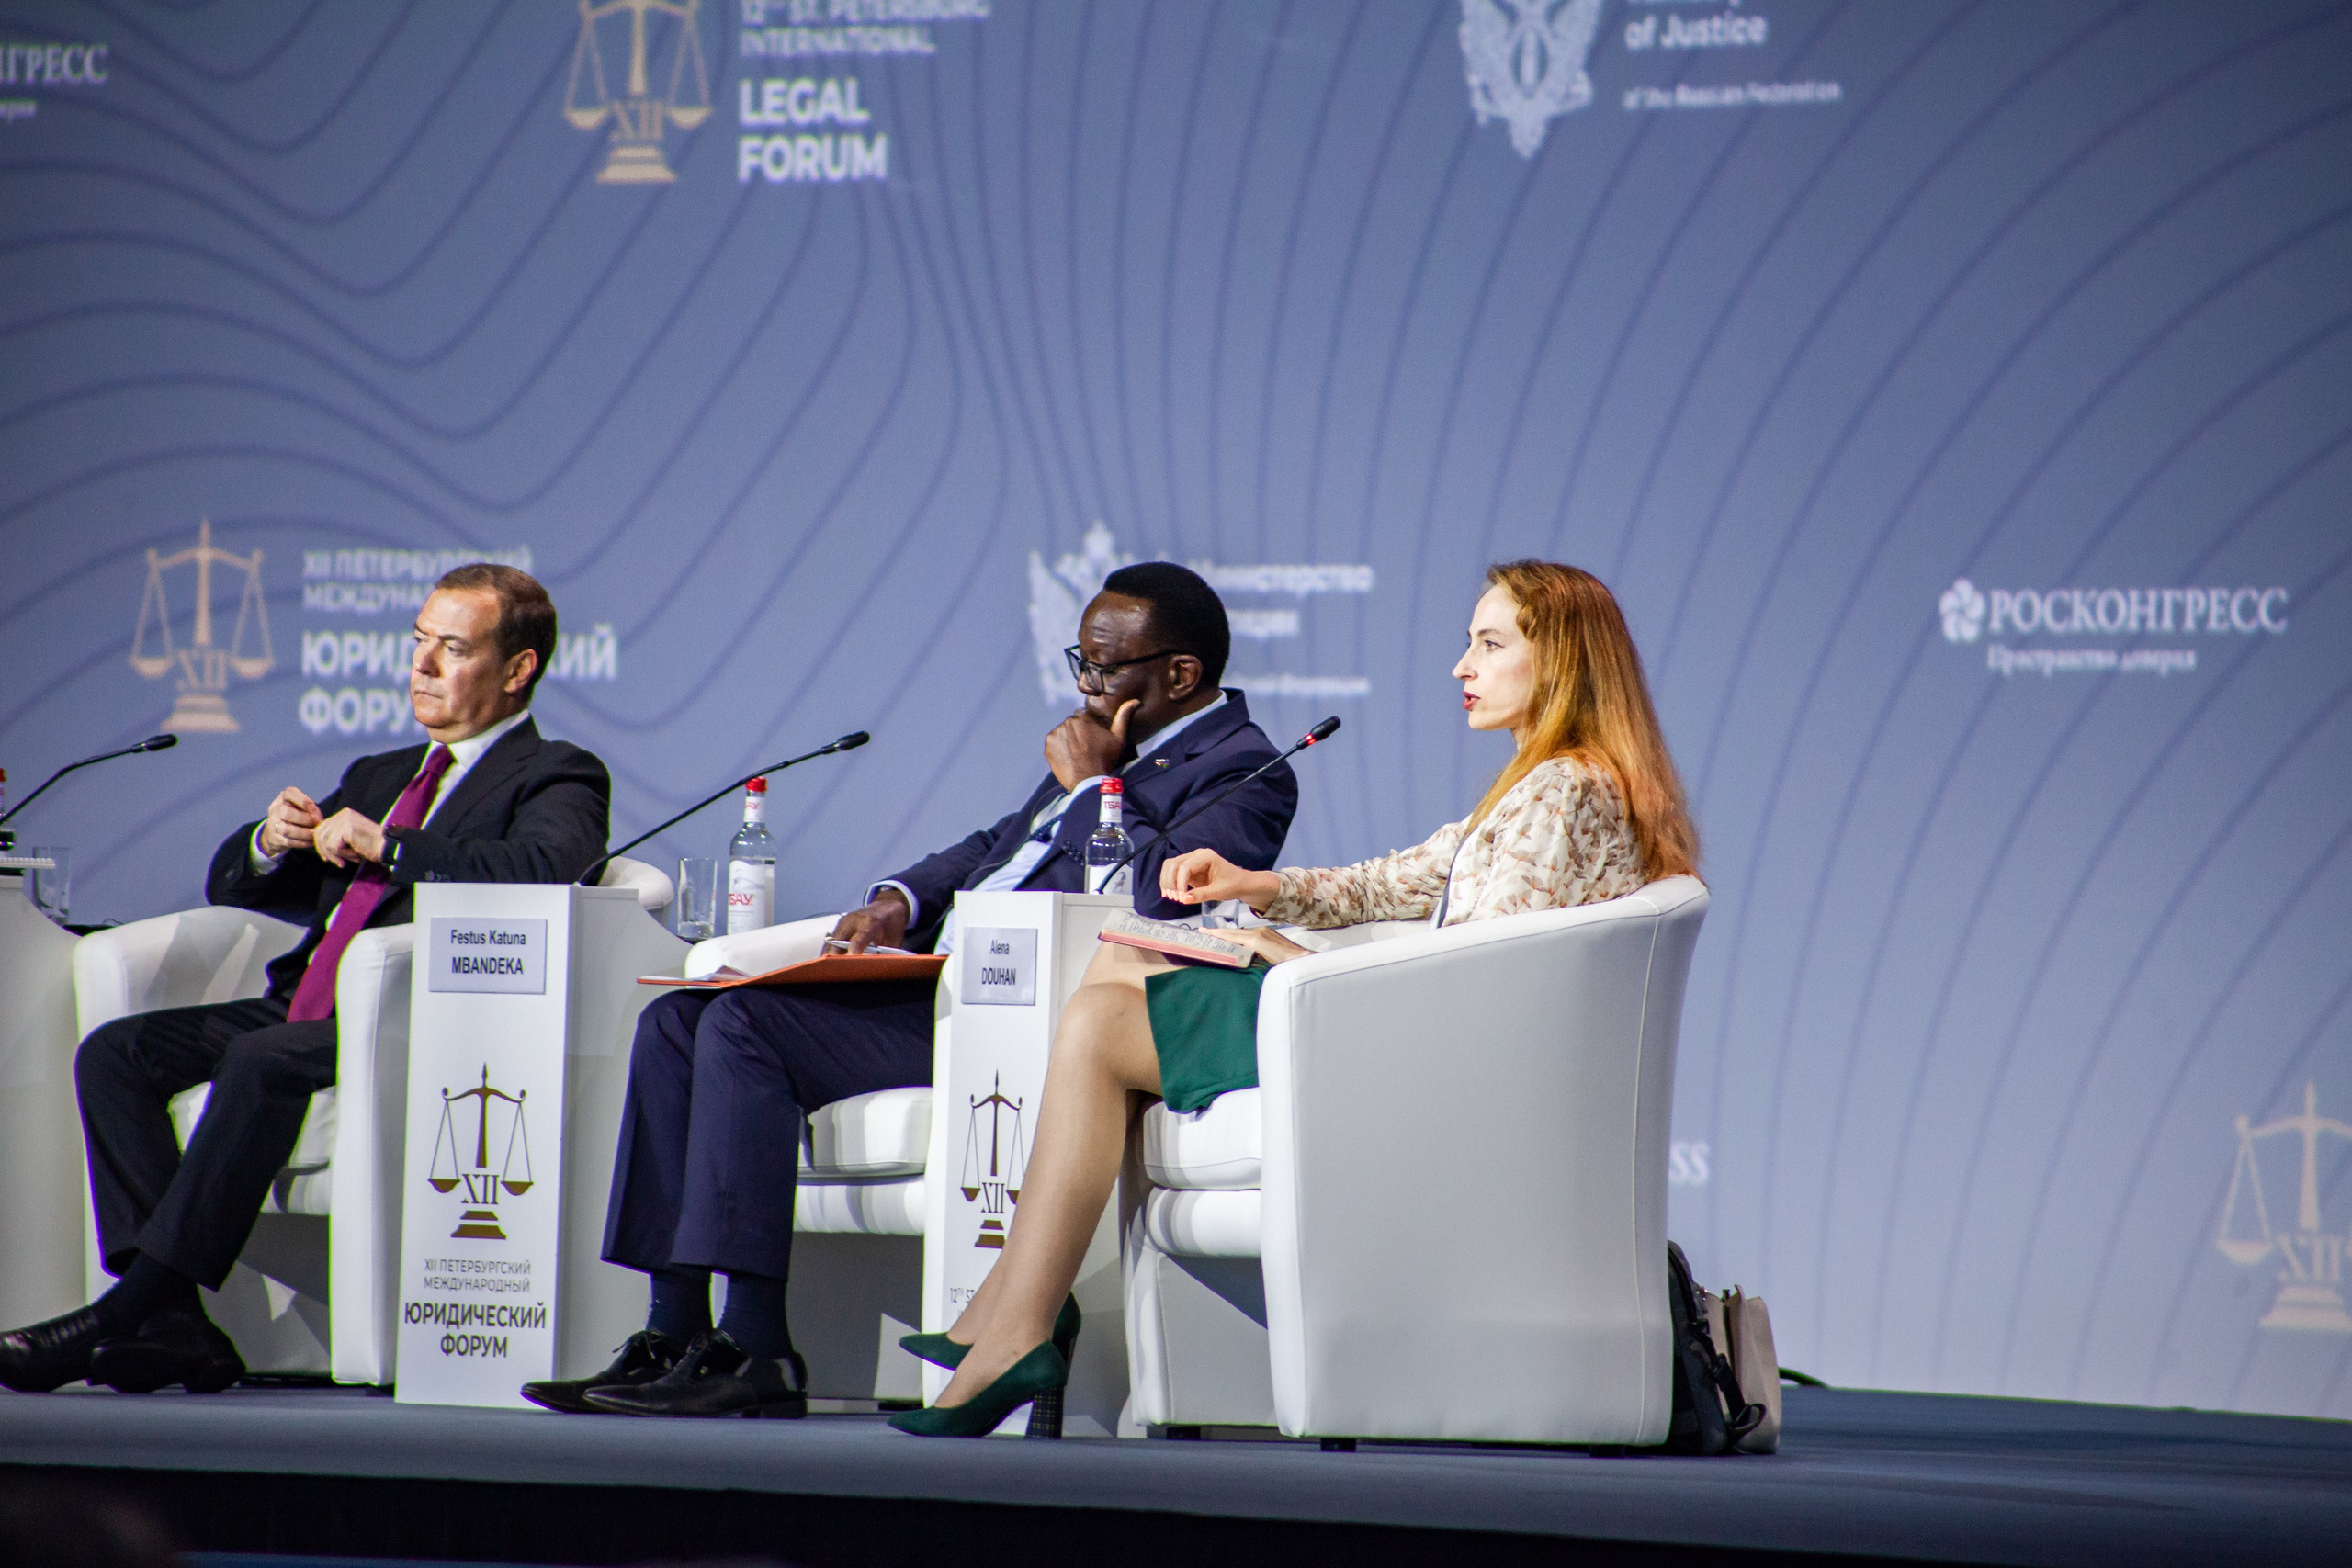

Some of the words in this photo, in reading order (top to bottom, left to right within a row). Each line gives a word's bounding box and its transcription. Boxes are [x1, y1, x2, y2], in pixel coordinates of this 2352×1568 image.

[1624, 15, 1656, 50] of
[1659, 11, 1768, 48] Justice
[739, 77, 871, 126] LEGAL
[738, 133, 888, 182] FORUM
[1988, 587, 2289, 633] РОСКОНГРЕСС
[298, 686, 428, 735] ФОРУ
[450, 929, 486, 945] Festus
[489, 930, 526, 946] Katuna
[989, 939, 1010, 955] Alena
[451, 956, 525, 975] MBANDEKA
[981, 967, 1016, 986] DOUHAN
[461, 1173, 500, 1205] XII
[424, 1258, 437, 1272] XII
[439, 1259, 532, 1275] ПЕТЕРБУРГСКИЙ
[424, 1276, 531, 1294] МЕЖДУНАРОДНЫЙ
[404, 1301, 548, 1330] ЮРИДИЧЕСКИЙ
[440, 1333, 509, 1359] ФОРУМ
